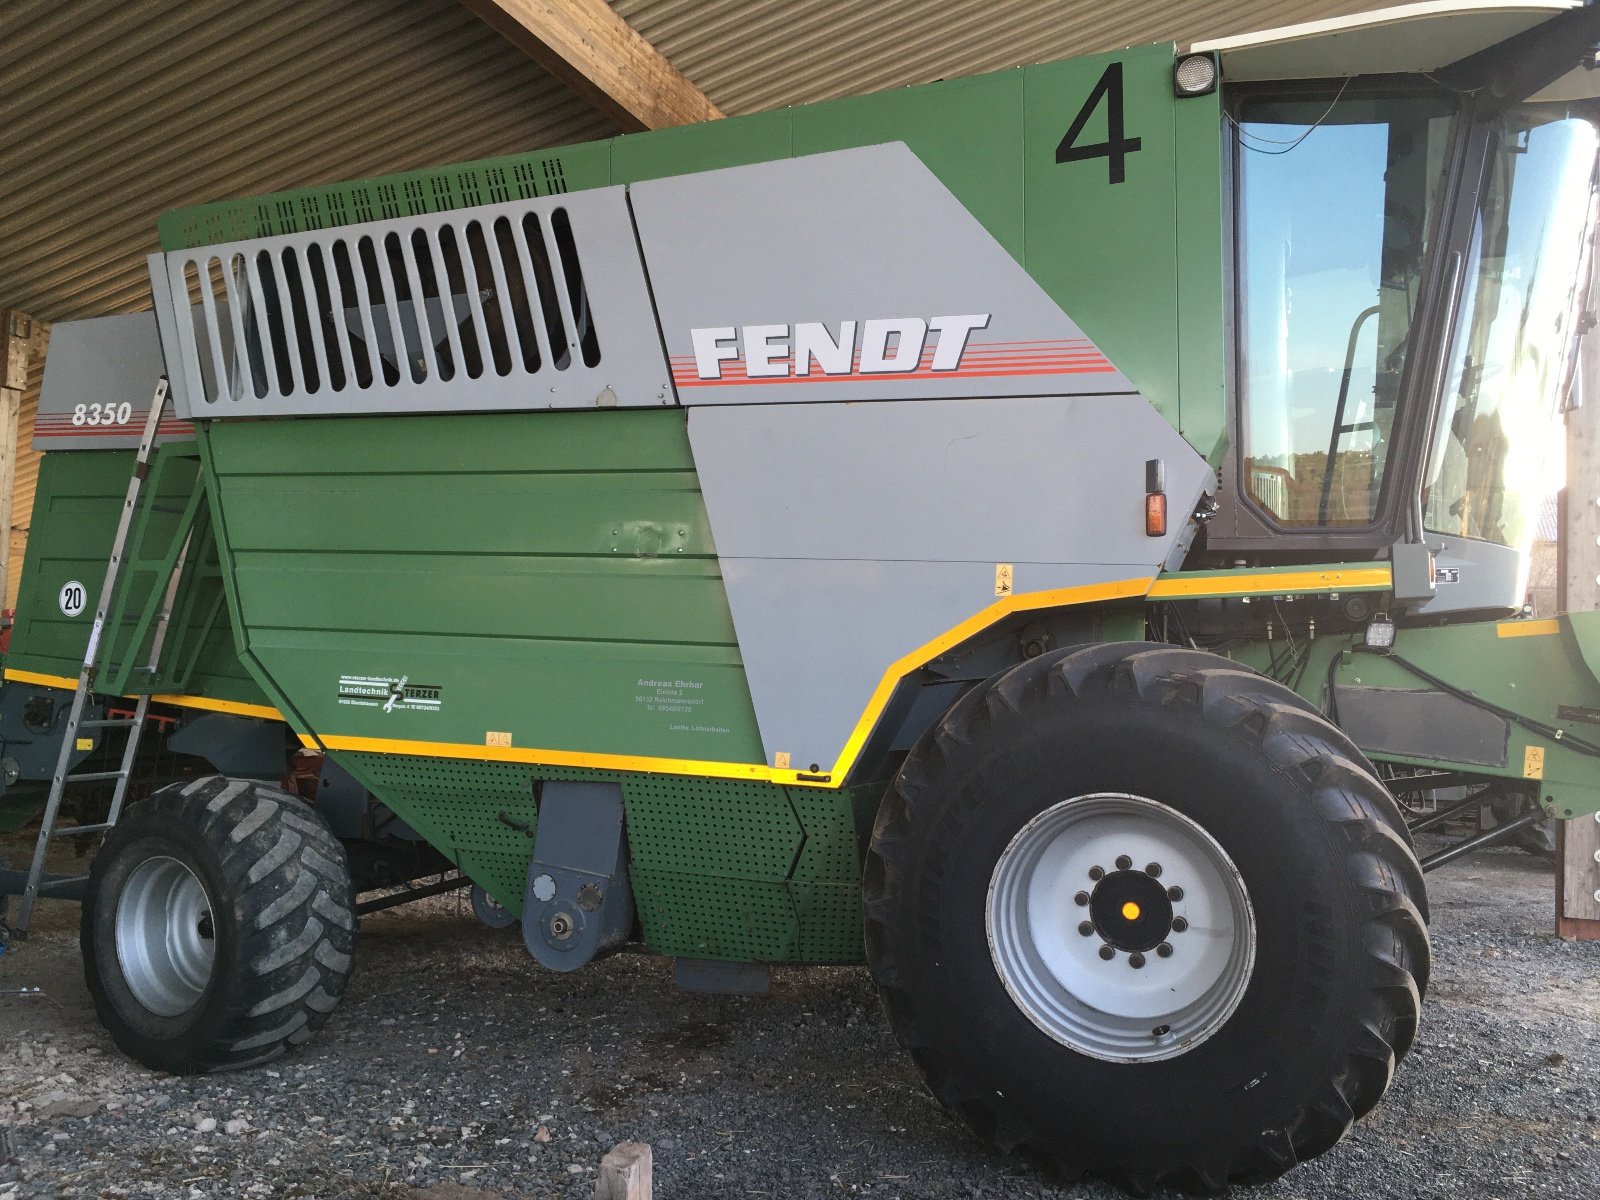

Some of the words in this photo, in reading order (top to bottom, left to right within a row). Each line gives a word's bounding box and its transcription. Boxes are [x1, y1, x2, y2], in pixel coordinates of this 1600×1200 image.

[1056, 62, 1141, 184] 4
[691, 313, 992, 380] FENDT
[72, 402, 132, 425] 8350
[65, 587, 81, 609] 20
[339, 685, 388, 696] Landtechnik
[637, 678, 673, 687] Andreas
[675, 680, 704, 689] Ehrbar
